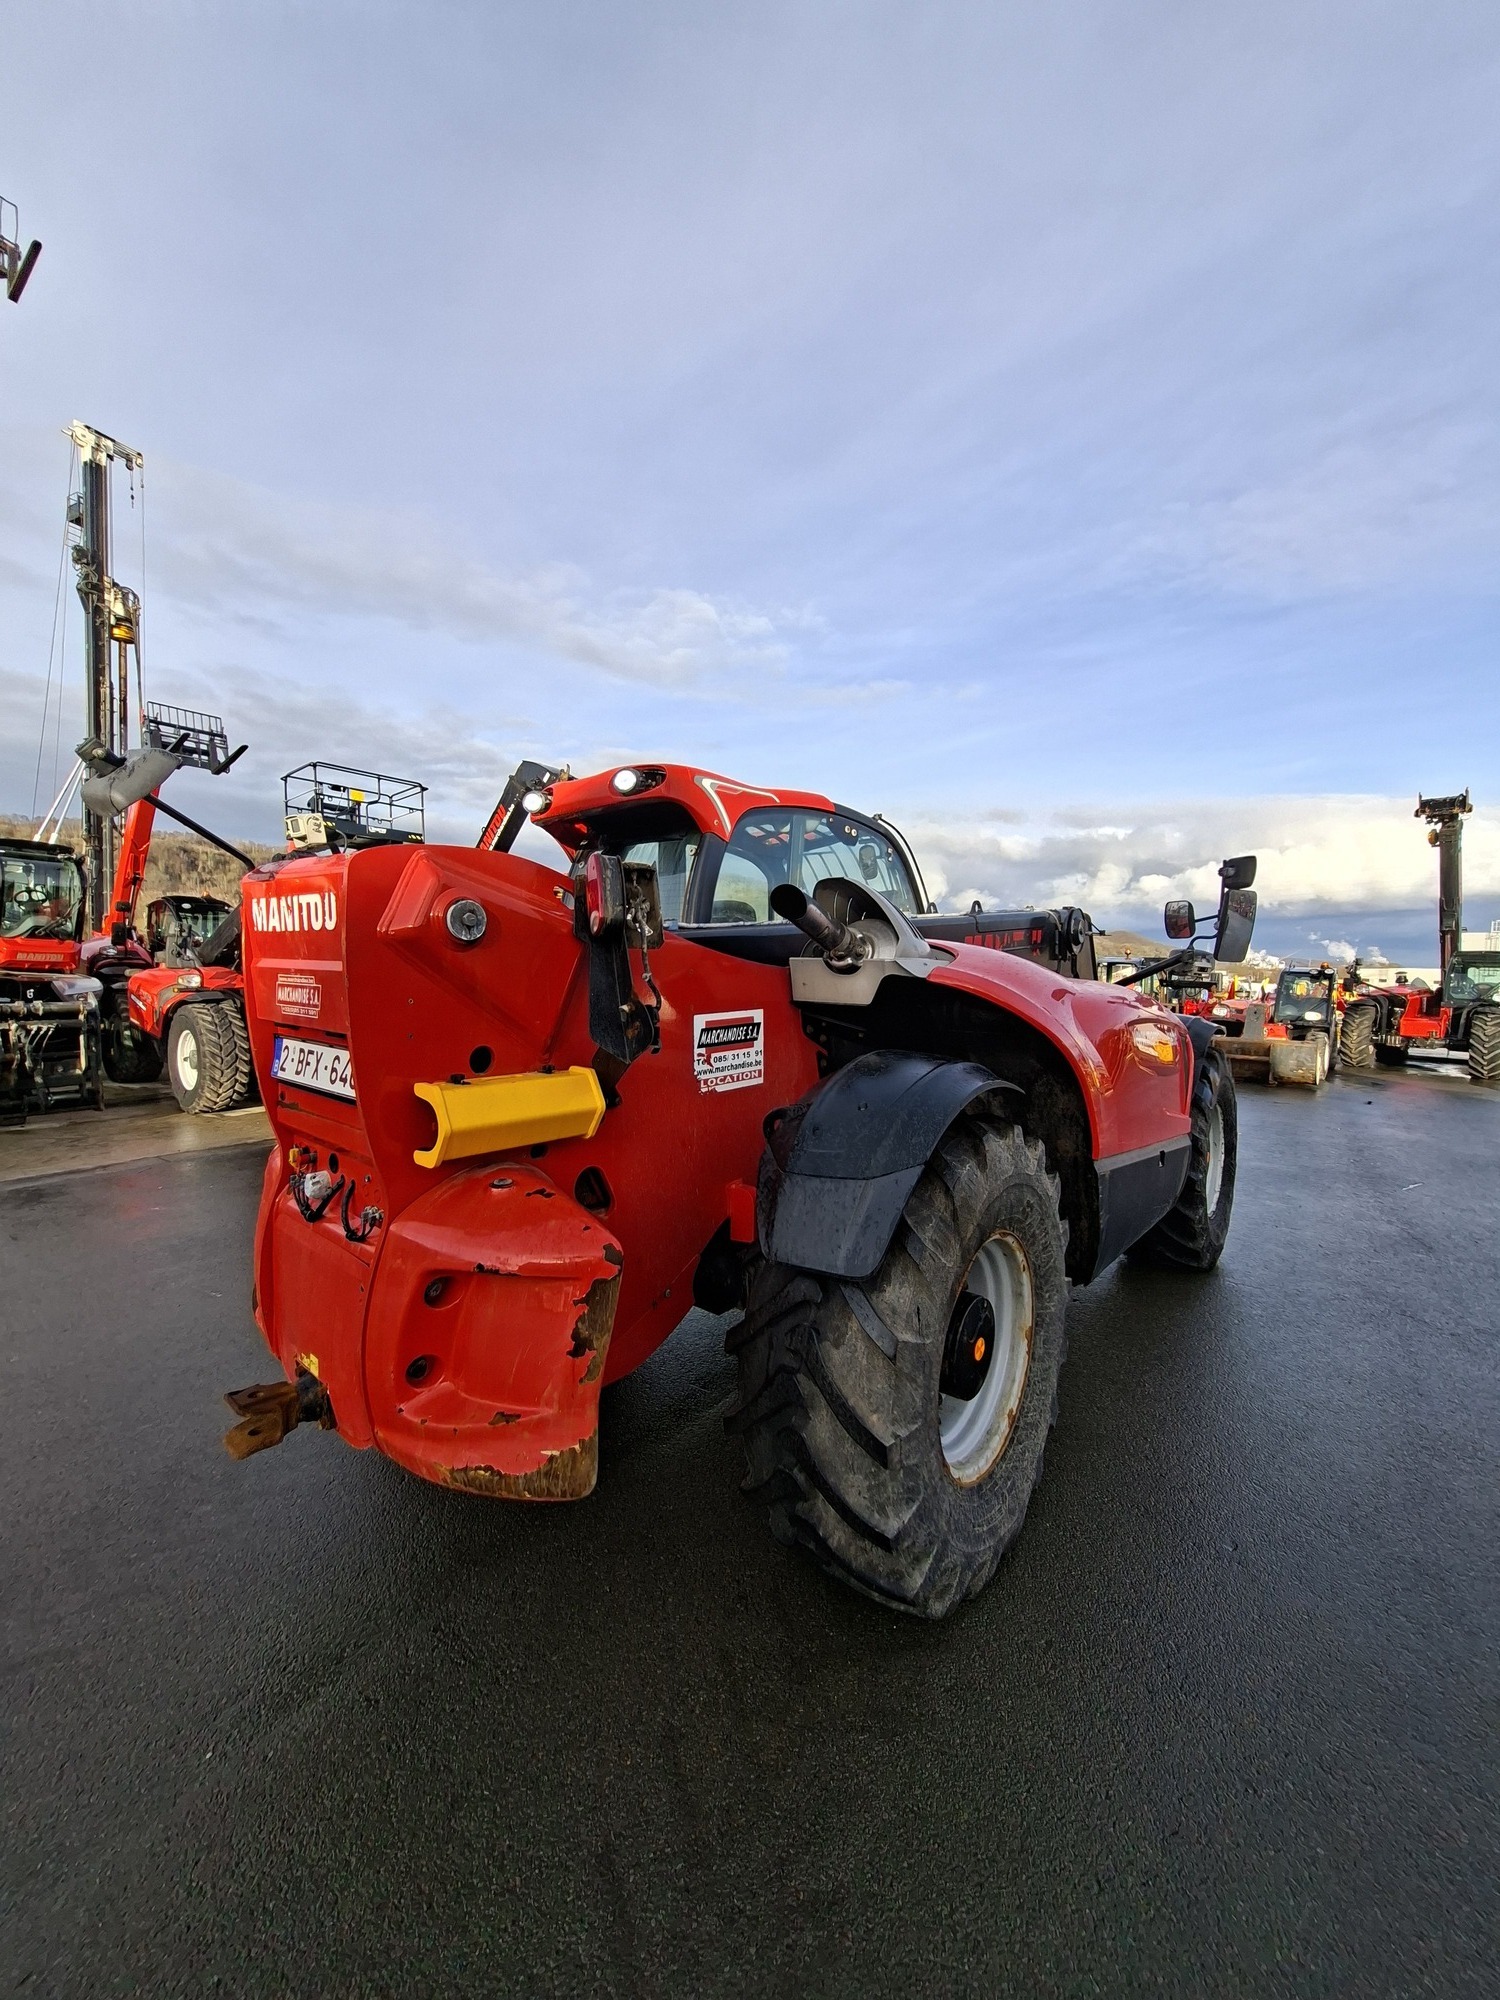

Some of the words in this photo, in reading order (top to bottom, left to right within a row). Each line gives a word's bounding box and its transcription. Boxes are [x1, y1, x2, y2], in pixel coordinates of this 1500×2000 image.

[480, 803, 507, 851] ANITOU
[251, 891, 337, 932] MANITOU
[16, 952, 64, 961] MANITOU
[278, 986, 309, 1004] MARCHANDISE
[699, 1026, 747, 1045] MARCHANDISE
[731, 1052, 740, 1061] 31
[742, 1050, 751, 1059] 15
[754, 1049, 762, 1057] 91
[696, 1059, 762, 1077] www.marchandise.be
[700, 1069, 759, 1088] LOCATION
